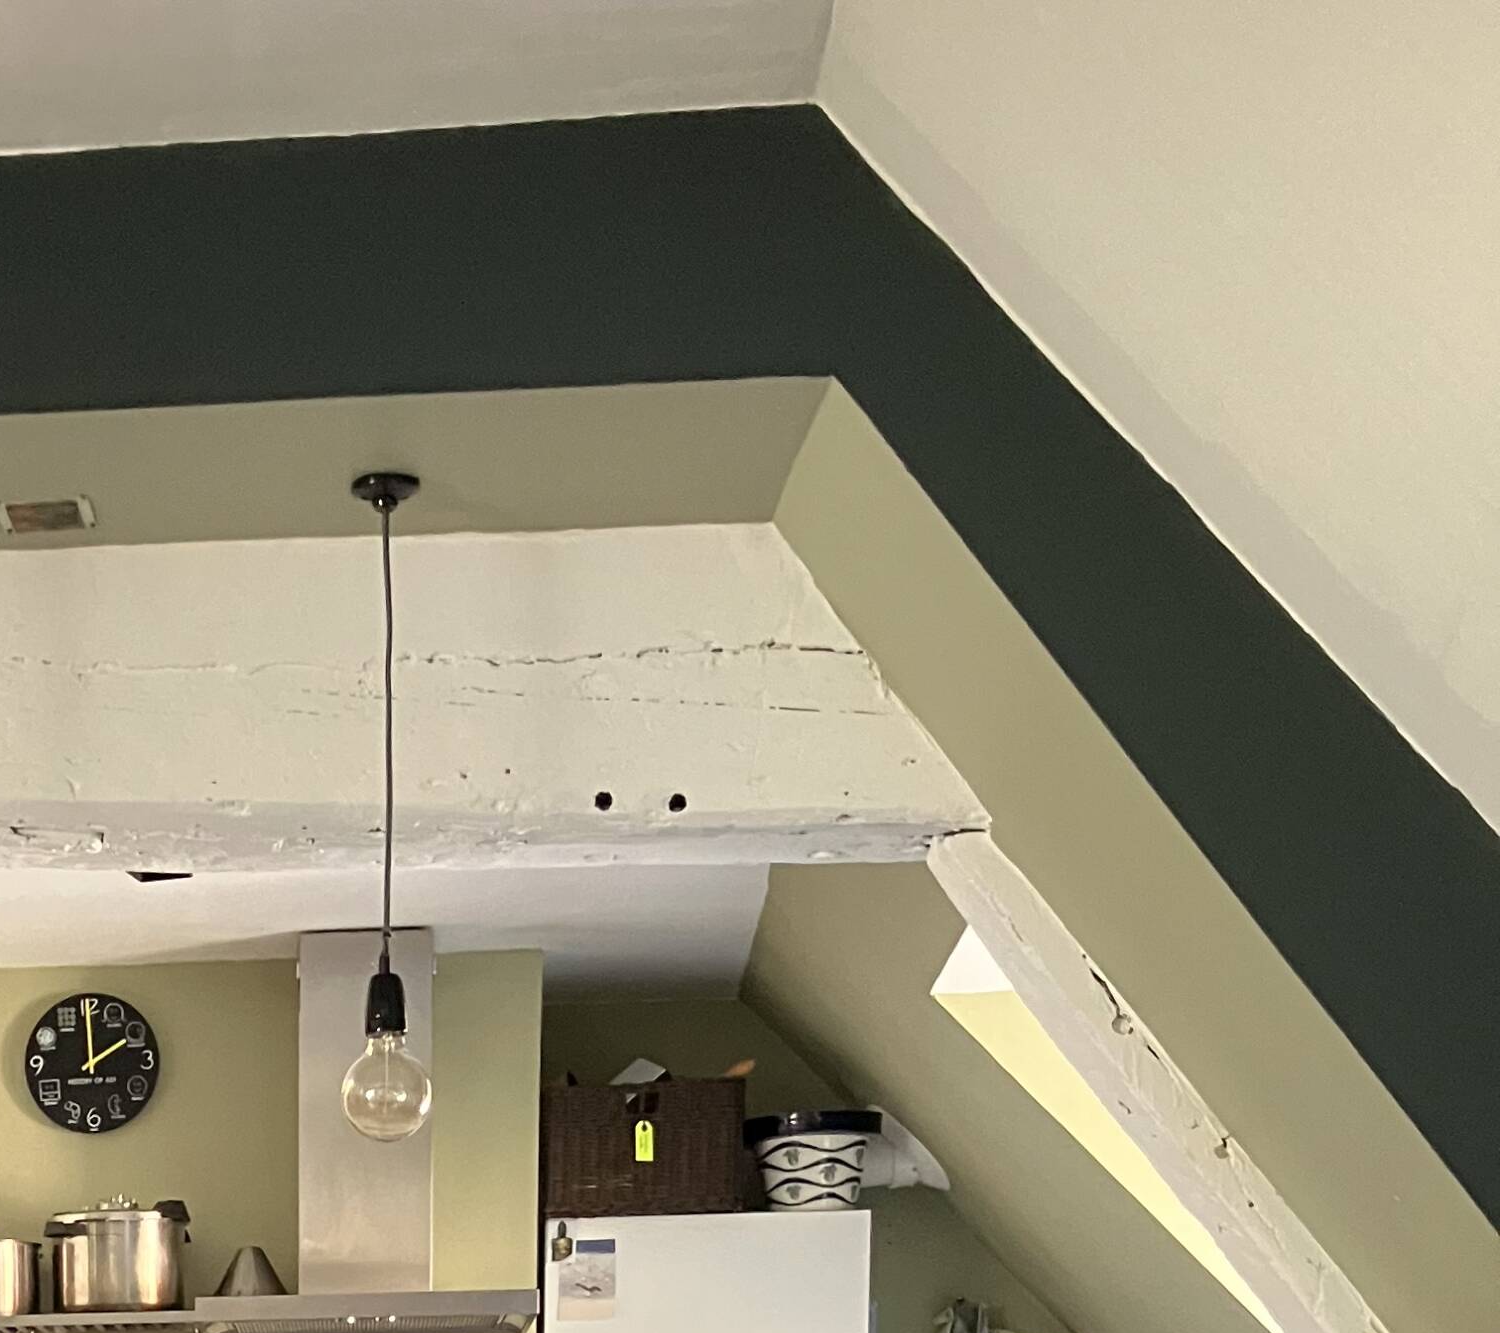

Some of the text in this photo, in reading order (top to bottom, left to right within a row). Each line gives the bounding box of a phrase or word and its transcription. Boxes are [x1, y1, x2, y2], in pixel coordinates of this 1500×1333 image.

[80, 998, 100, 1017] 12
[30, 1055, 44, 1076] 9
[140, 1050, 155, 1070] 3
[86, 1107, 101, 1127] 6
